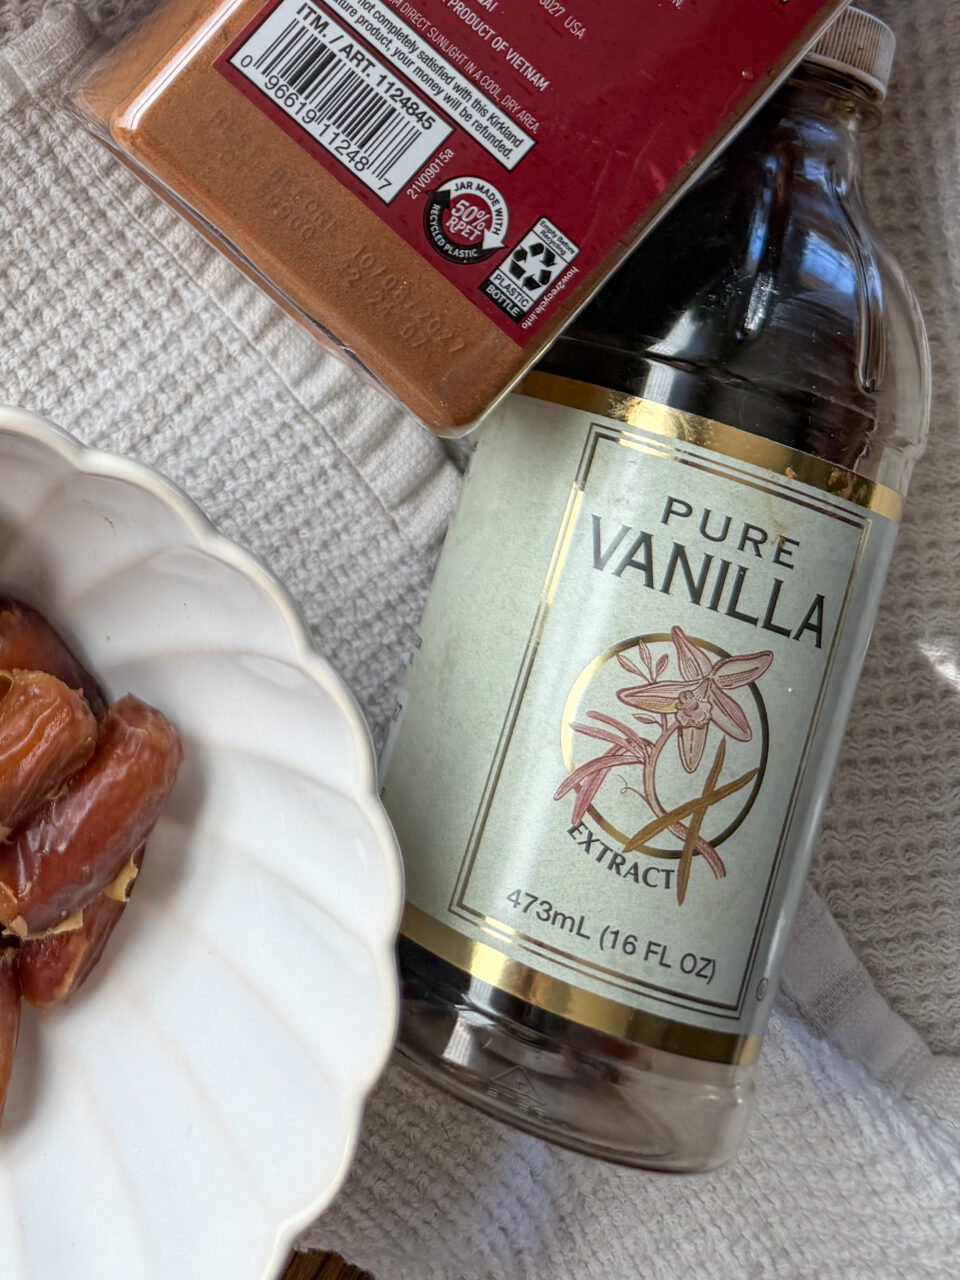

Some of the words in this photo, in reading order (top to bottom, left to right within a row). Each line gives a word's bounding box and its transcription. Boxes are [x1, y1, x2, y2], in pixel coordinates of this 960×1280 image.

[398, 1, 431, 34] DIRECT
[561, 14, 589, 40] USA
[294, 1, 334, 40] ITM.
[336, 39, 378, 79] ART.
[371, 71, 437, 133] 1124845
[424, 25, 469, 68] SUNLIGHT
[462, 59, 477, 75] IN
[488, 34, 509, 55] OF
[502, 46, 550, 93] VIETNAM
[353, 12, 396, 53] product,
[389, 45, 416, 72] your
[409, 64, 446, 99] money
[440, 90, 463, 113] will
[456, 105, 475, 124] be
[469, 116, 516, 161] refunded.
[369, 7, 421, 57] completely
[414, 47, 456, 87] satisfied
[449, 79, 474, 104] with
[468, 96, 491, 119] this
[484, 111, 525, 150] Kirkland
[471, 67, 485, 81] A
[476, 73, 506, 102] COOL,
[237, 52, 255, 71] 0
[261, 72, 319, 127] 96619
[315, 120, 371, 174] 11248
[375, 176, 393, 195] 7
[499, 93, 522, 116] DRY
[514, 107, 543, 135] AREA.
[404, 145, 455, 201] 21V09015a
[446, 216, 482, 241] RPET
[450, 199, 491, 230] 50%
[454, 181, 474, 193] JAR
[475, 182, 500, 207] MADE
[491, 207, 504, 236] WITH
[429, 203, 445, 247] RECYCLED
[442, 244, 478, 258] PLASTIC
[539, 220, 558, 239] Empty
[556, 234, 575, 255] Before
[539, 231, 566, 256] Recycling
[485, 284, 521, 317] BOTTLE
[493, 273, 530, 308] PLASTIC
[521, 266, 579, 329] how2recycle.info
[660, 496, 800, 569] PURE
[591, 514, 826, 649] VANILLA
[567, 821, 675, 889] EXTRACT
[506, 888, 590, 940] 473mL
[599, 925, 638, 955] (16
[644, 940, 672, 969] FL
[680, 952, 716, 985] OZ)
